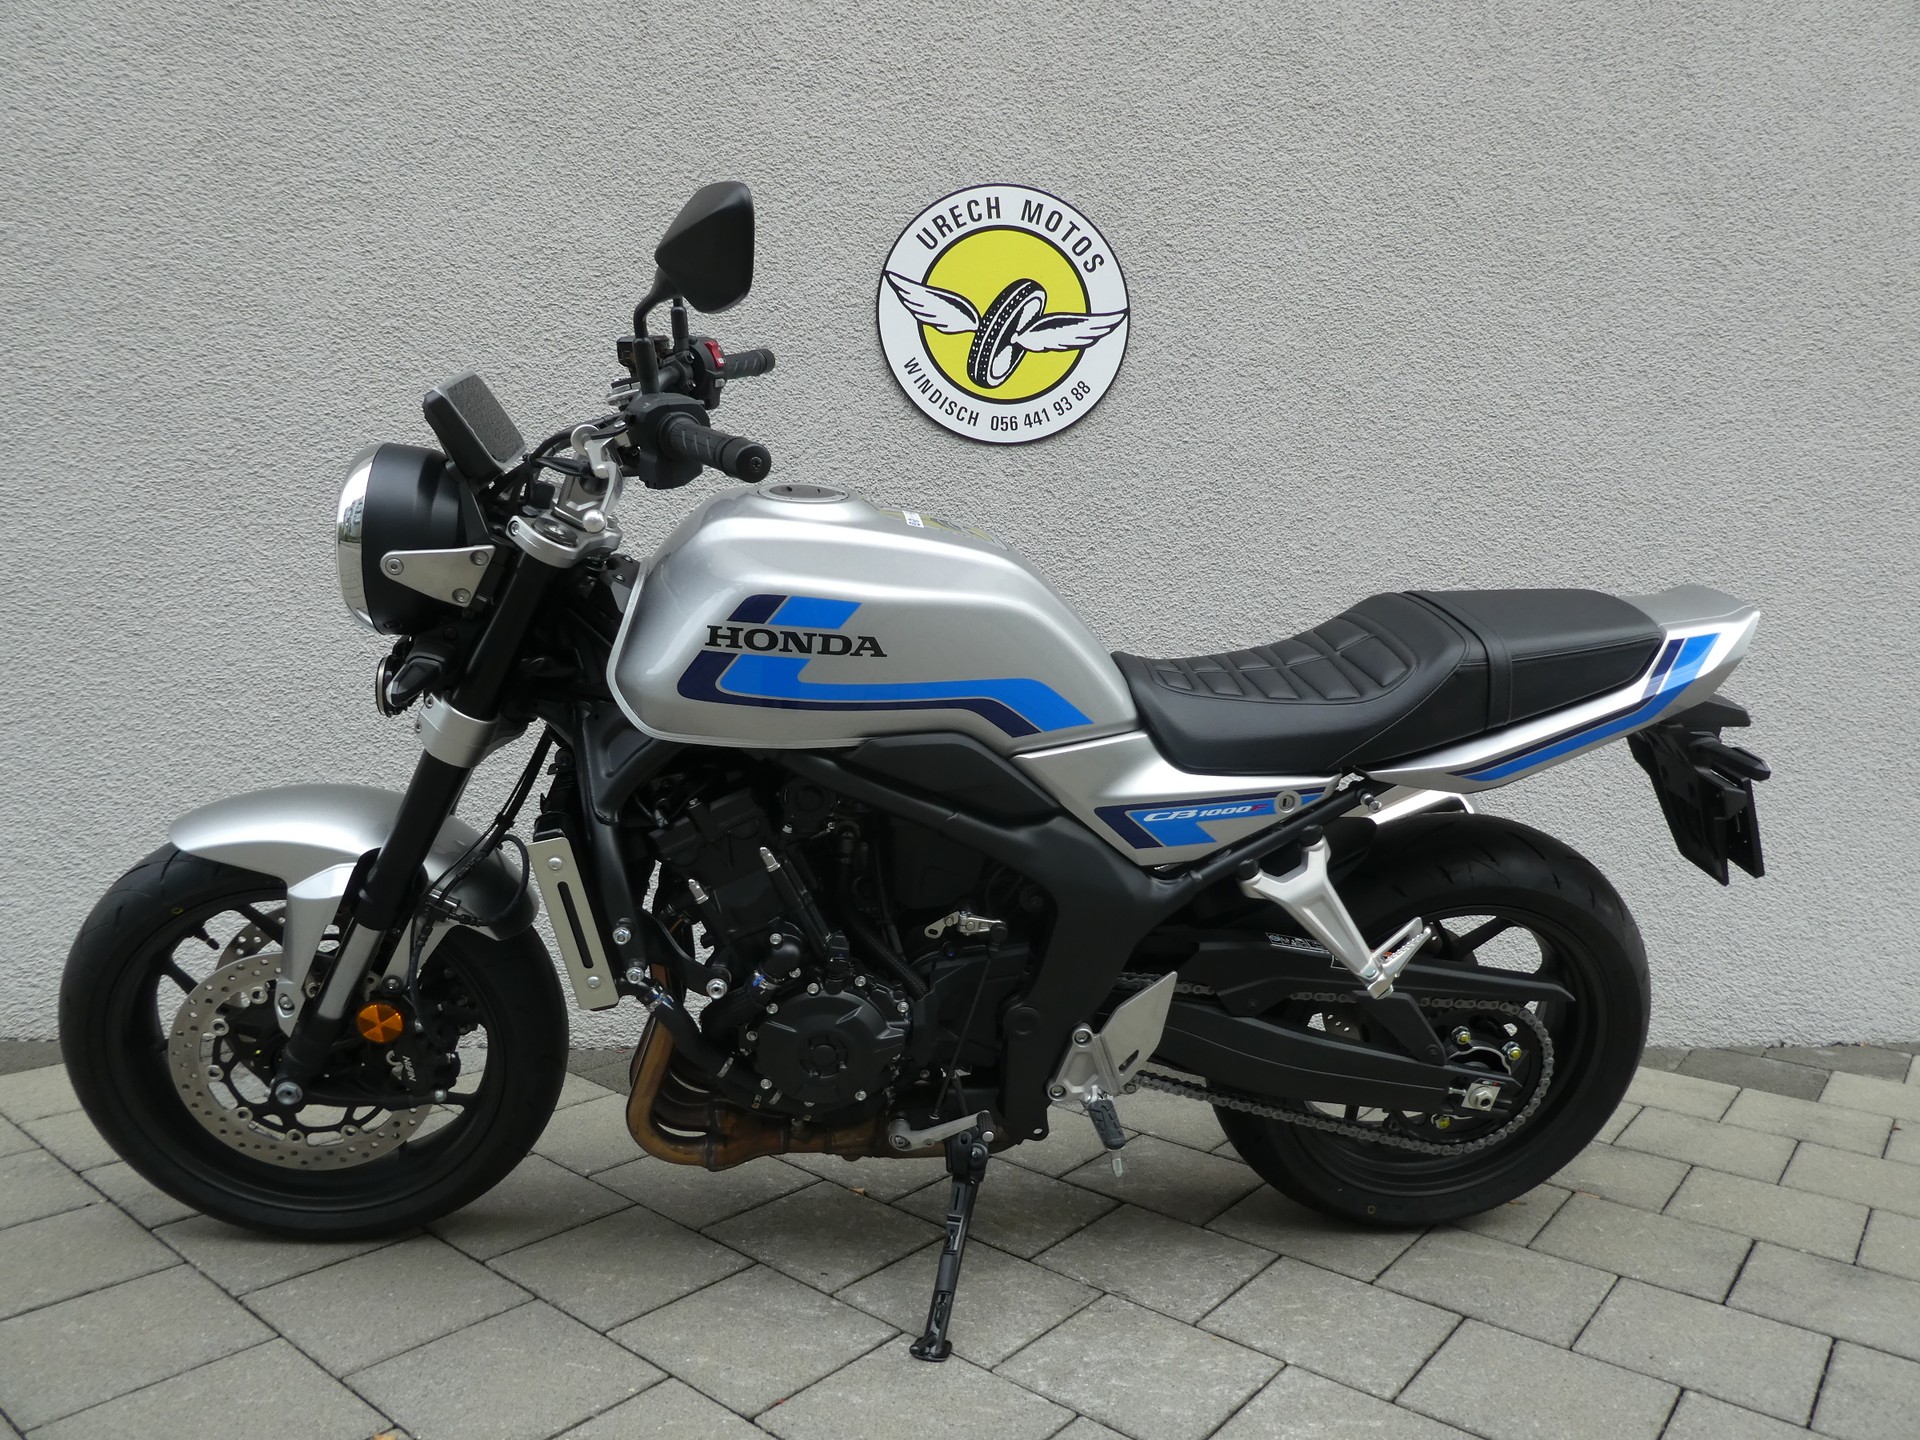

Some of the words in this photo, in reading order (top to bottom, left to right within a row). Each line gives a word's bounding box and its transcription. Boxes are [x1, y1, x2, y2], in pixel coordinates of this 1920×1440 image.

[916, 196, 1001, 250] URECH
[1020, 199, 1105, 273] MOTOS
[903, 357, 980, 427] WINDISCH
[990, 415, 1018, 431] 056
[1023, 407, 1050, 428] 441
[1054, 396, 1073, 417] 93
[1071, 380, 1091, 401] 88
[704, 625, 887, 657] HONDA
